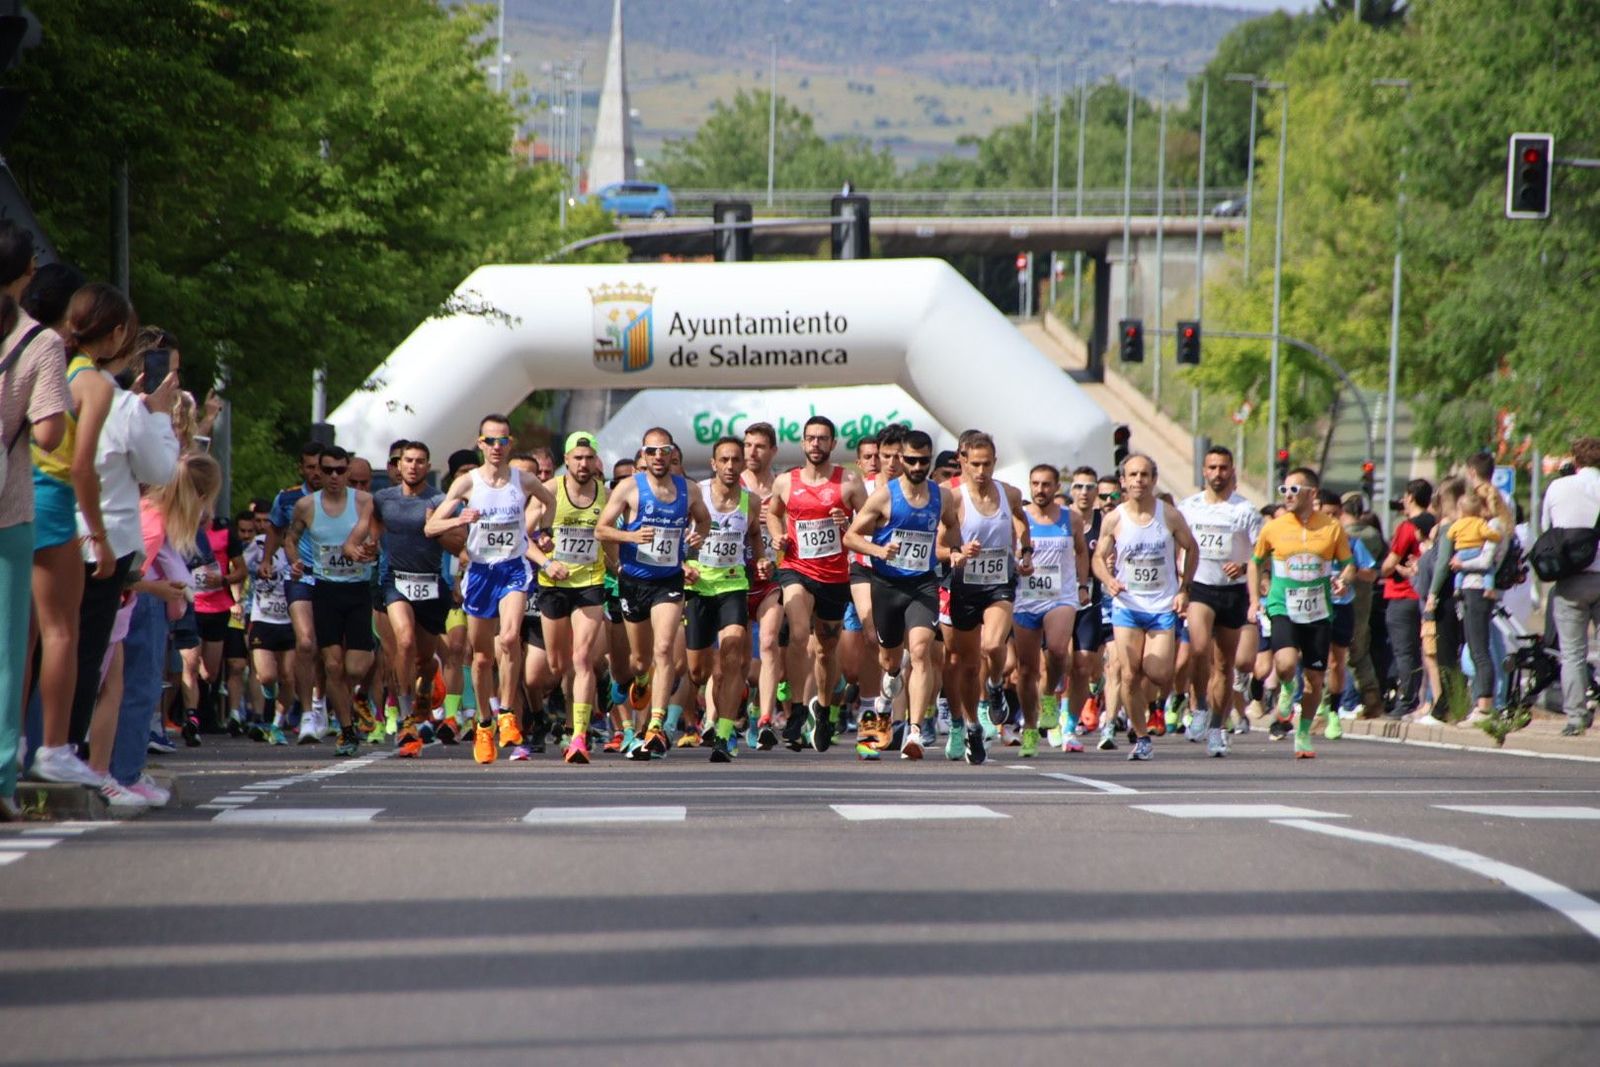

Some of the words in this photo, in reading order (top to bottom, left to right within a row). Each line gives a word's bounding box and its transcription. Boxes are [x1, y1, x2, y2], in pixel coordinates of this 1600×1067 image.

[668, 310, 848, 342] Ayuntamiento
[669, 346, 699, 367] de
[709, 344, 848, 367] Salamanca
[693, 411, 723, 444] El
[727, 413, 802, 443] Cte
[487, 532, 514, 546] 642
[560, 537, 595, 554] 1727
[802, 528, 836, 547] 1829
[1200, 534, 1223, 548] 274
[650, 539, 673, 555] 143
[705, 541, 738, 557] 1438
[897, 542, 928, 559] 1750
[970, 558, 1004, 575] 1156
[194, 573, 209, 586] 52
[1028, 576, 1052, 590] 640
[1134, 568, 1159, 582] 592
[405, 584, 430, 598] 185
[268, 601, 287, 614] 709
[1296, 596, 1319, 612] 701
